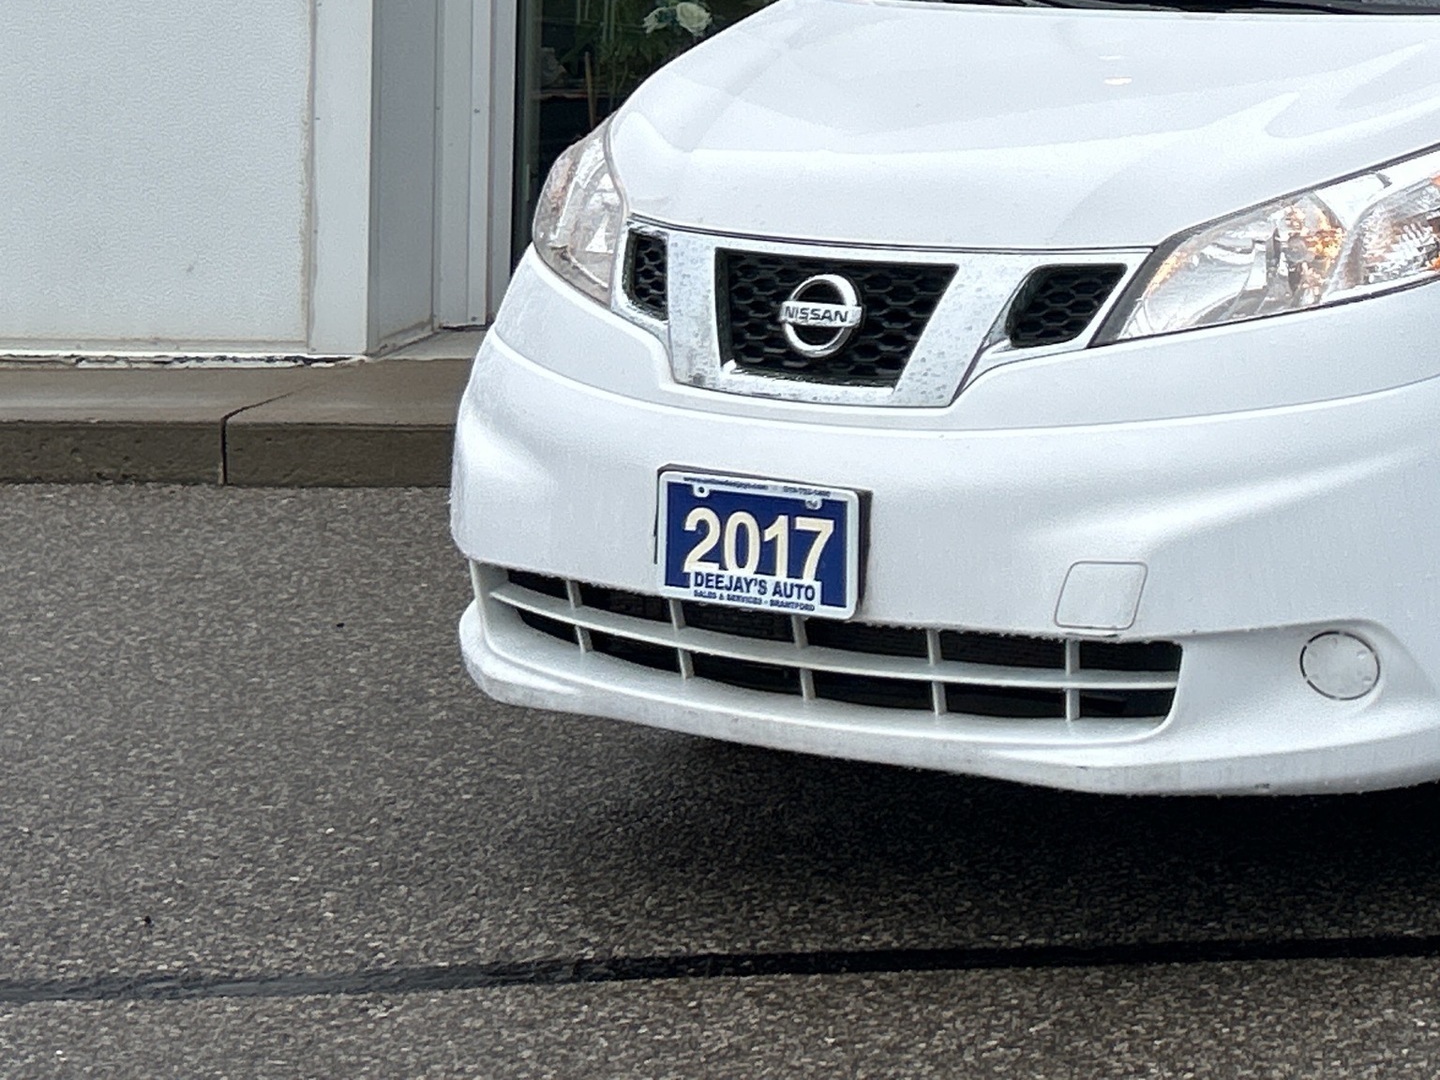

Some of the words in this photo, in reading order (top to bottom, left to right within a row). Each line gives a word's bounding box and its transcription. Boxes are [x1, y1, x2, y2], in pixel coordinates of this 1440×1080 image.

[784, 306, 849, 323] NISSAN
[682, 507, 834, 582] 2017
[693, 571, 768, 596] DEEJAY'S
[772, 580, 816, 602] AUTO
